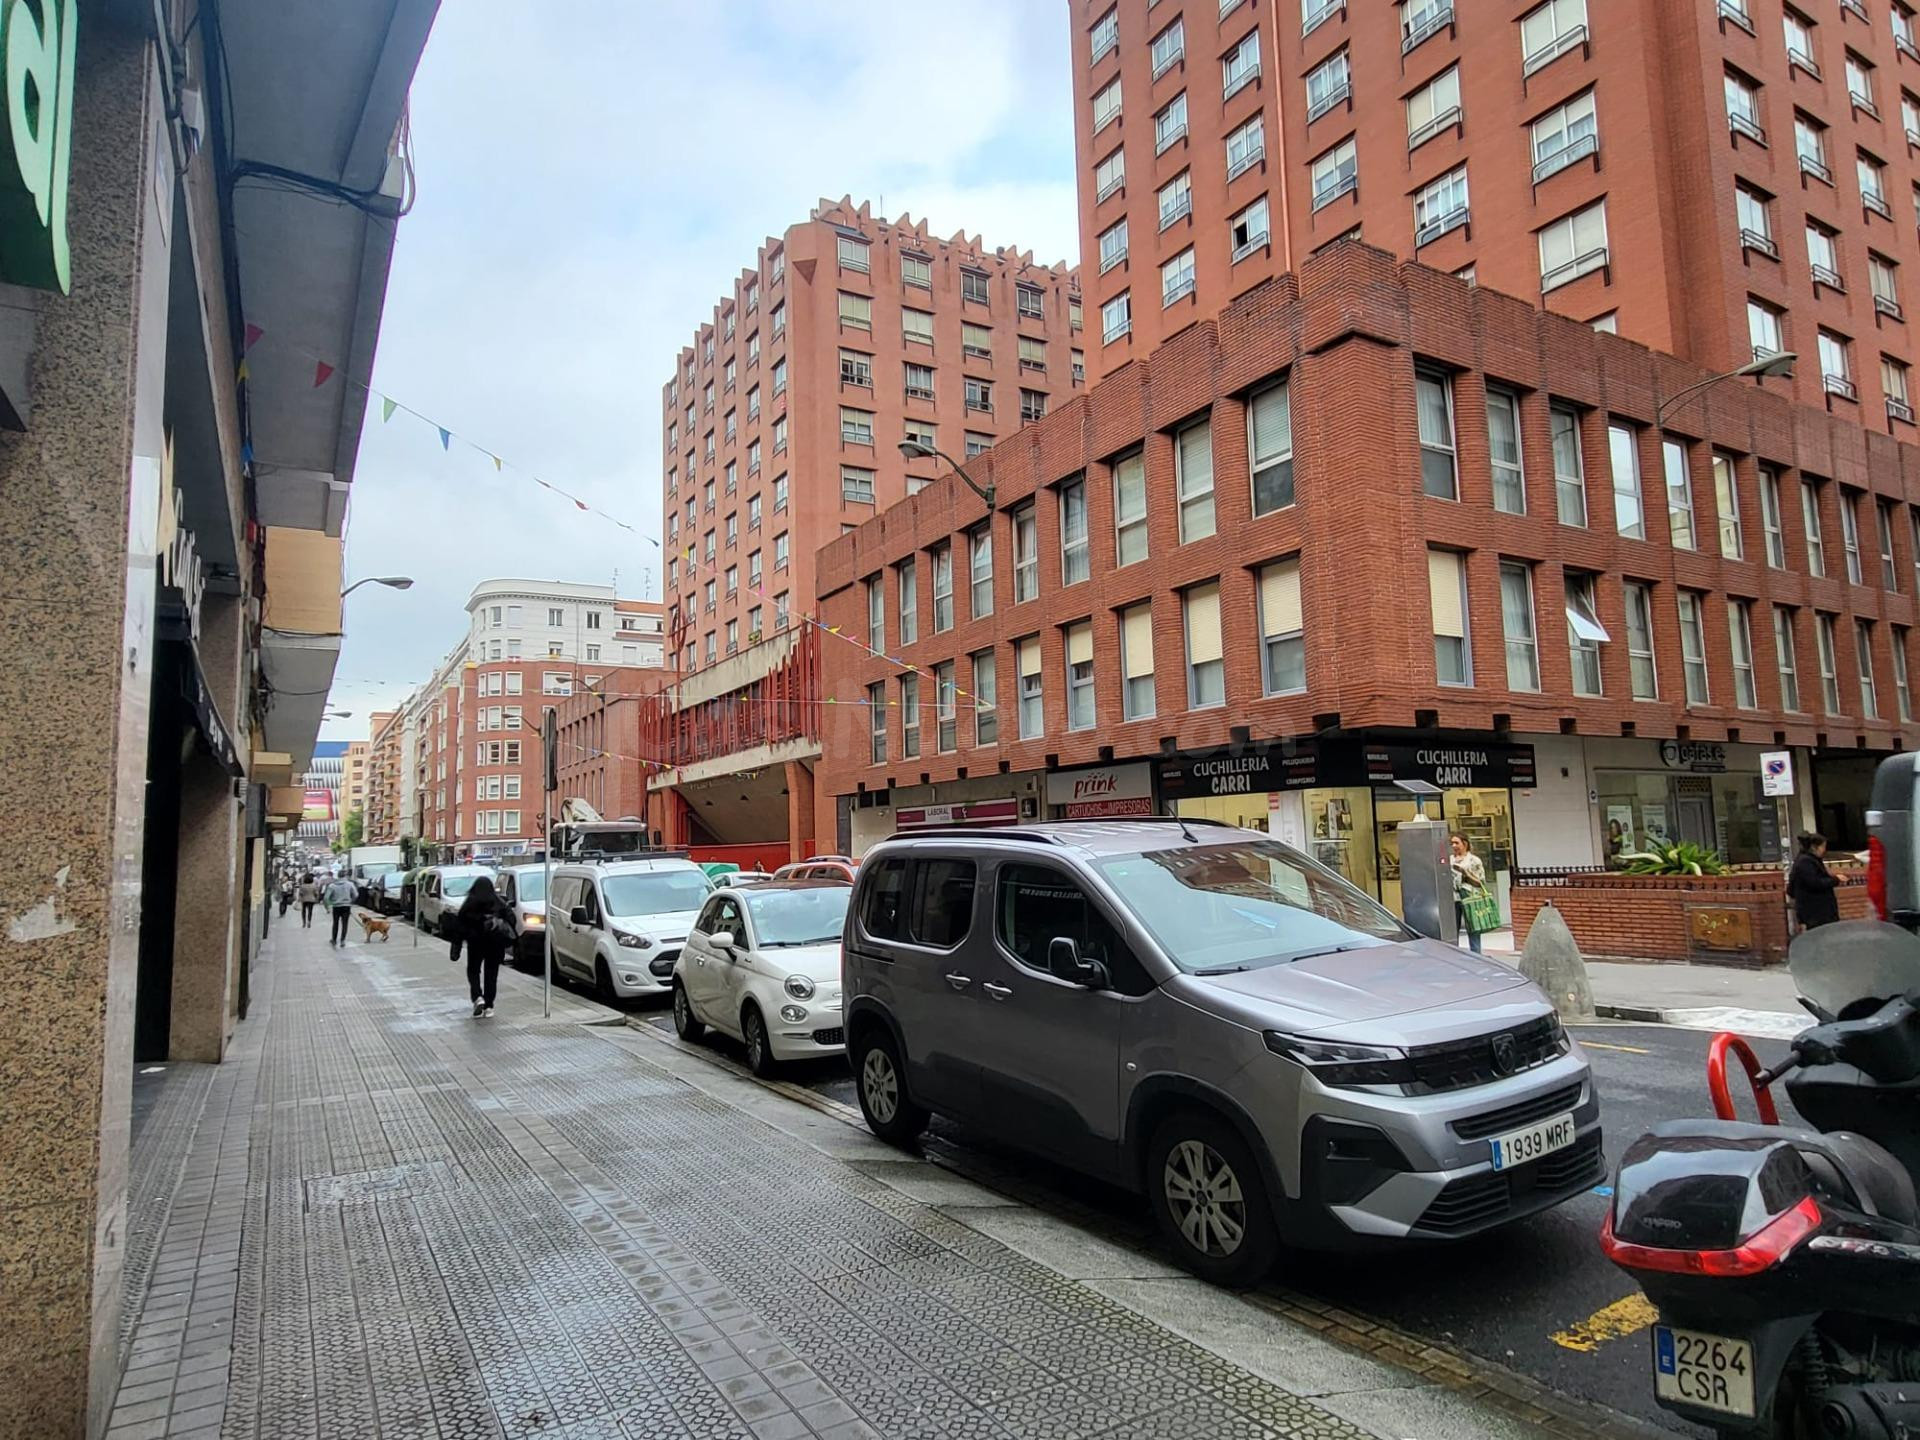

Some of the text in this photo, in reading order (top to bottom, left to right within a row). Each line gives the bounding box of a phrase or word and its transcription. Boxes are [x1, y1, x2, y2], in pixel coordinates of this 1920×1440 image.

[1193, 756, 1270, 777] CUCHILLERIA
[1416, 749, 1488, 766] CUCHILLERIA
[1211, 774, 1251, 794] CARRI
[1436, 766, 1472, 785] CARRI
[1074, 775, 1118, 799] prink
[927, 807, 949, 816] LABORAL
[1067, 802, 1103, 817] CARTUCHOS
[1107, 798, 1151, 814] IMPRESORAS
[1506, 1120, 1570, 1163] 1939 MRF
[1677, 1335, 1746, 1377] 2264
[1678, 1367, 1729, 1407] CSR
